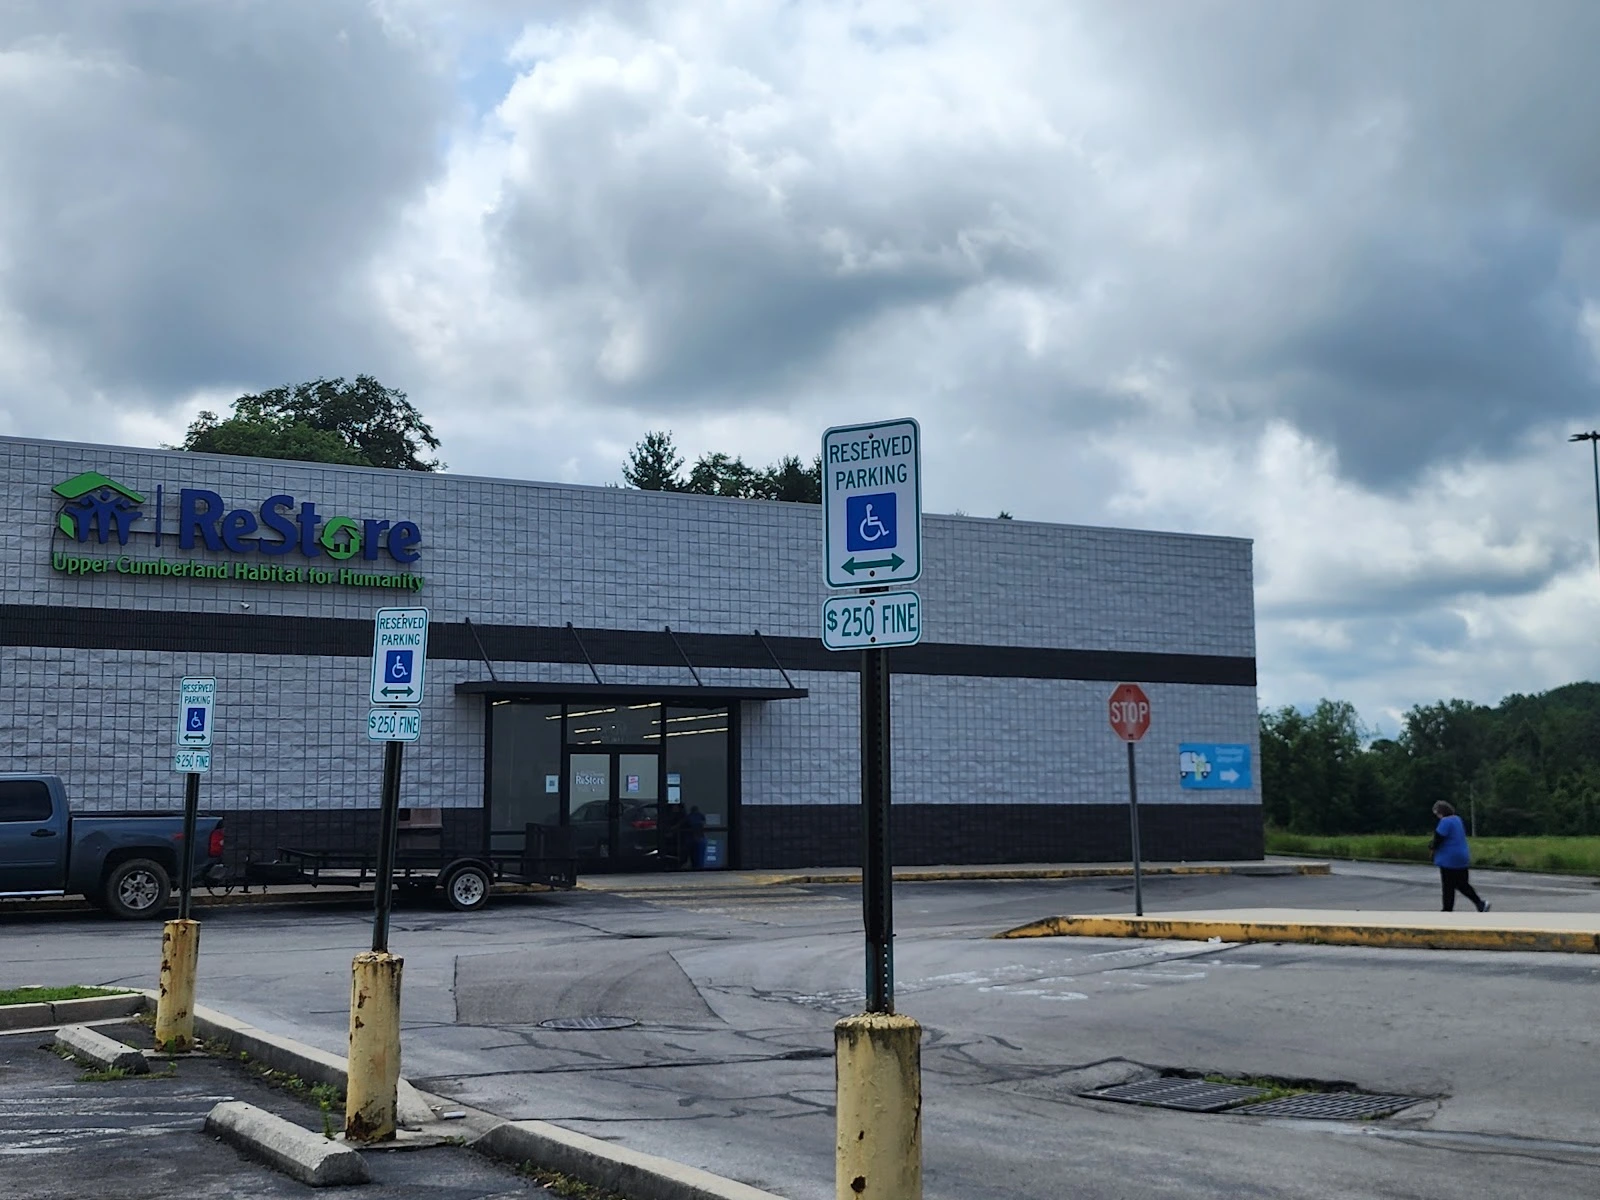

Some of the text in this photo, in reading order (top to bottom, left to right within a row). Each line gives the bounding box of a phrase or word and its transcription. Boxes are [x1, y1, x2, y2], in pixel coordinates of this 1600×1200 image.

[829, 434, 912, 464] RESERVED
[835, 463, 907, 491] PARKING
[179, 488, 422, 564] ReStore
[52, 551, 425, 593] Upper Cumberland Habitat for Humanity
[379, 617, 425, 630] RESERVED
[826, 602, 917, 637] $250 FINE
[381, 633, 421, 646] PARKING
[183, 683, 214, 693] RESERVED
[184, 695, 211, 705] PARKING
[1111, 701, 1149, 724] STOP
[369, 715, 419, 734] $250 FINE
[175, 754, 210, 768] $250 FINE
[575, 775, 605, 785] ReStore
